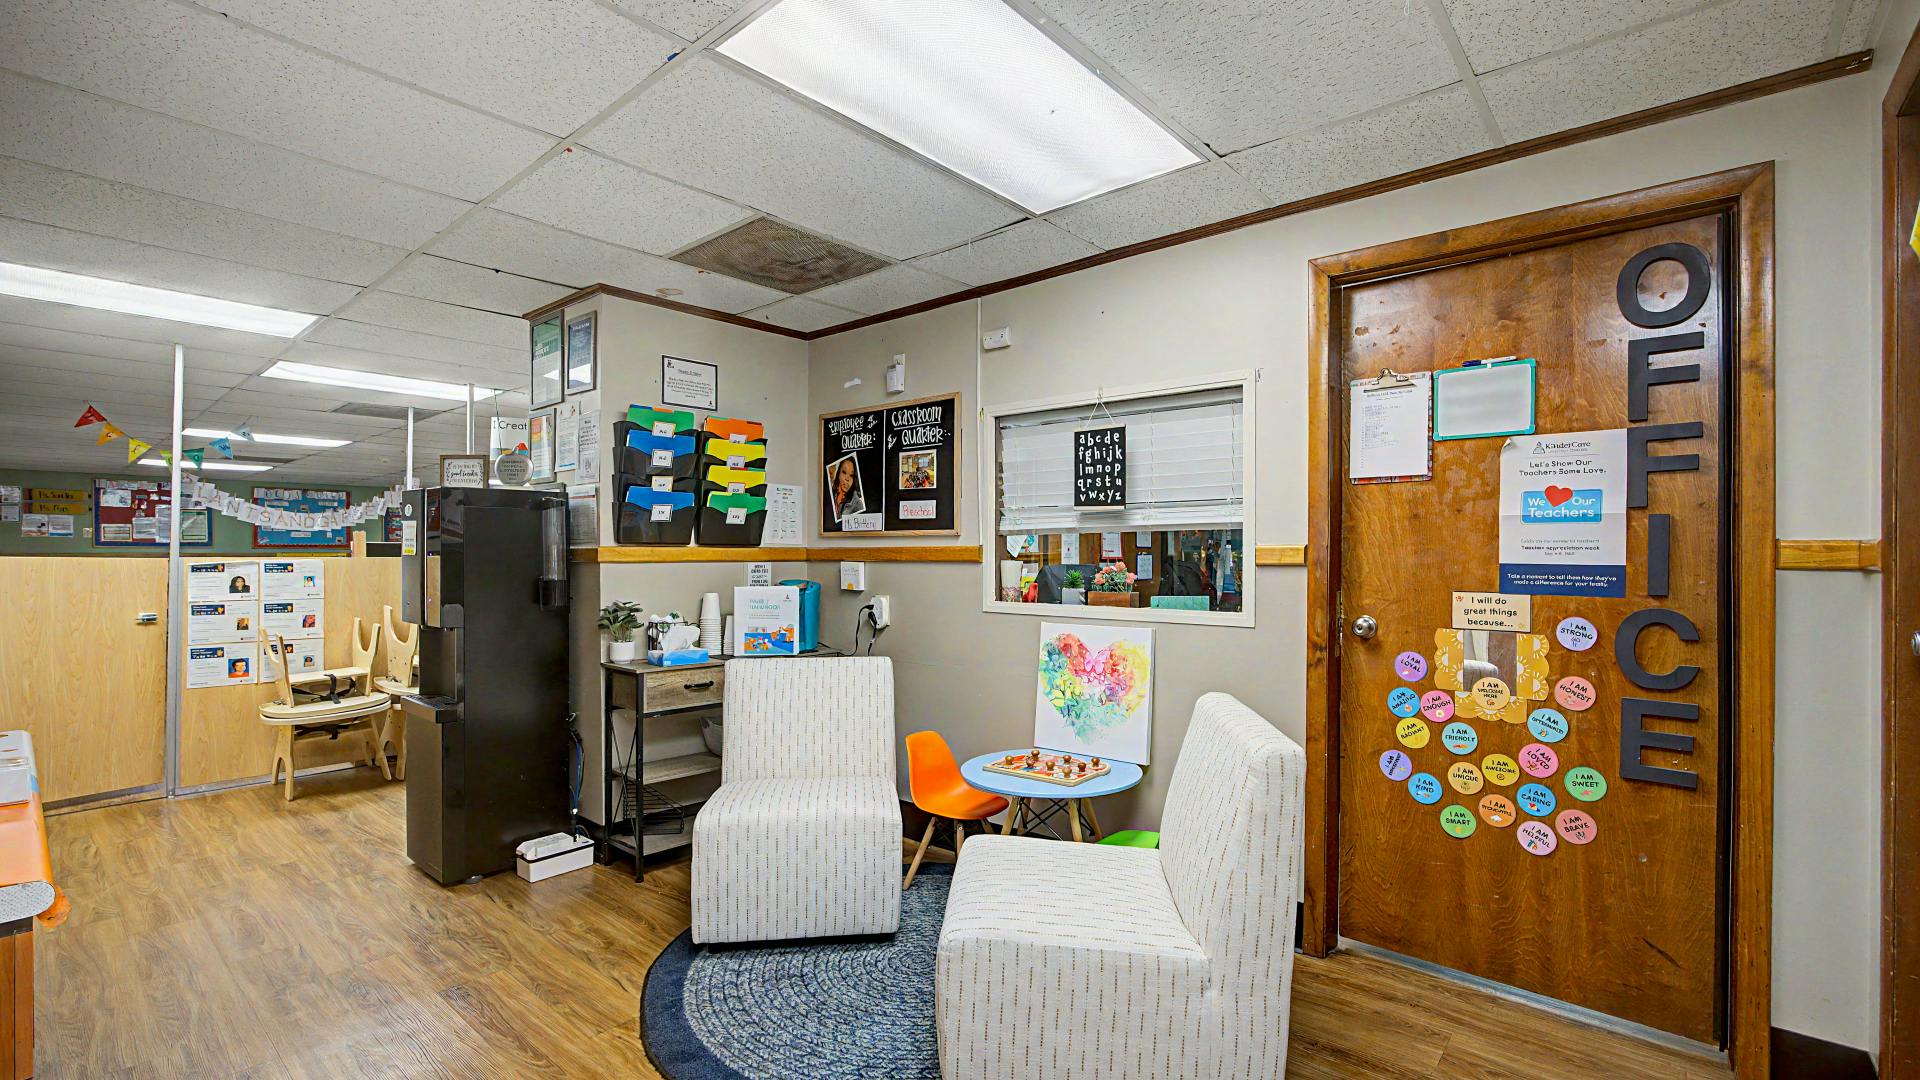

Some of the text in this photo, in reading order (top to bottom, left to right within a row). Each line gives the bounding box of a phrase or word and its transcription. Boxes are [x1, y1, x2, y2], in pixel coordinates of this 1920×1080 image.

[1545, 441, 1591, 449] KinderCare
[1529, 460, 1550, 468] Let's
[1583, 466, 1607, 474] Love.
[1527, 496, 1596, 506] We Our
[902, 505, 934, 517] Preschool
[1527, 506, 1594, 518] Teachers
[1614, 242, 1712, 790] OFFICE
[1471, 596, 1507, 605] I will do
[1463, 608, 1518, 617] great things
[1560, 628, 1594, 640] STRONG
[1400, 659, 1421, 673] LOYAL
[1559, 684, 1591, 702] HONEST
[1575, 684, 1588, 693] AM
[1396, 691, 1406, 699] AM
[1423, 700, 1451, 711] ENOUGH
[1546, 716, 1559, 726] AM
[1406, 722, 1417, 731] AM
[1386, 755, 1394, 765] AM
[1527, 750, 1550, 770] LOVED
[1540, 752, 1552, 763] AM
[1453, 774, 1479, 782] UNIQUE
[1416, 784, 1434, 793] KIND
[1494, 801, 1506, 809] AM
[1569, 816, 1582, 824] AM
[1564, 822, 1590, 833] BRAVE
[1535, 829, 1549, 839] AM
